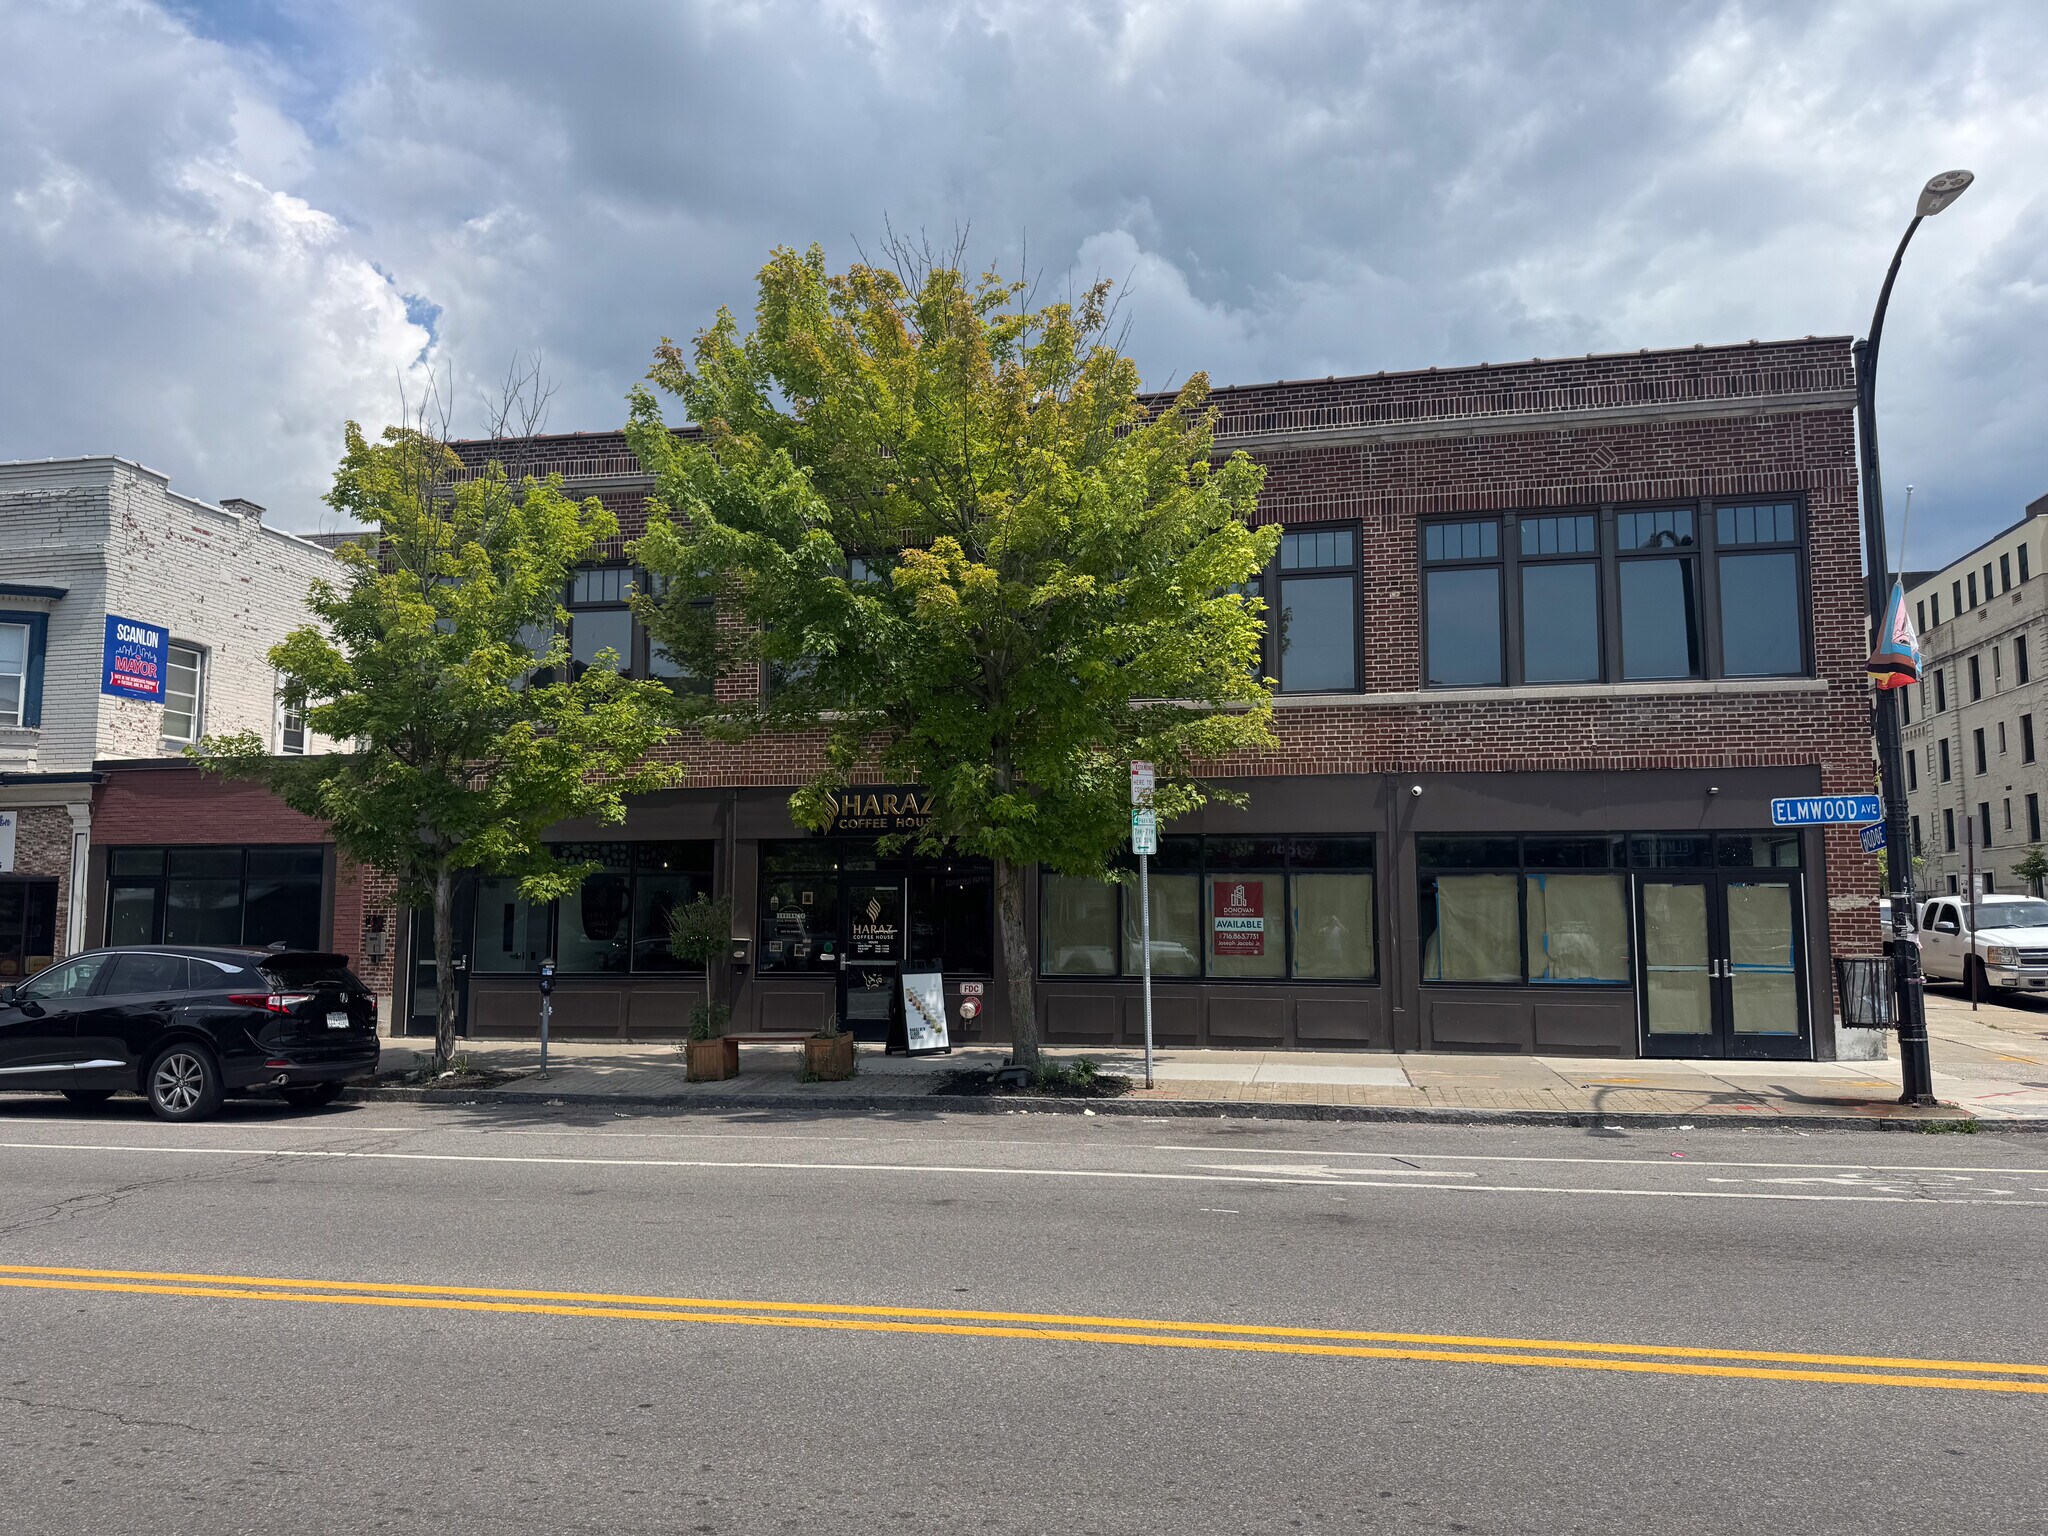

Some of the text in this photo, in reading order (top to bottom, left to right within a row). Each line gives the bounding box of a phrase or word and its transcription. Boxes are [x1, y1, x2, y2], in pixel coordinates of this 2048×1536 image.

[117, 624, 159, 648] SCANLON
[115, 656, 157, 678] MAYOR
[841, 793, 936, 816] HARAZ
[1776, 800, 1877, 822] ELMWOOD AVE
[839, 818, 888, 829] COFFEE
[1861, 826, 1886, 849] HODGE
[853, 924, 893, 934] HARAZ
[1216, 920, 1262, 929] AVAILABLE
[964, 984, 980, 993] FDC
